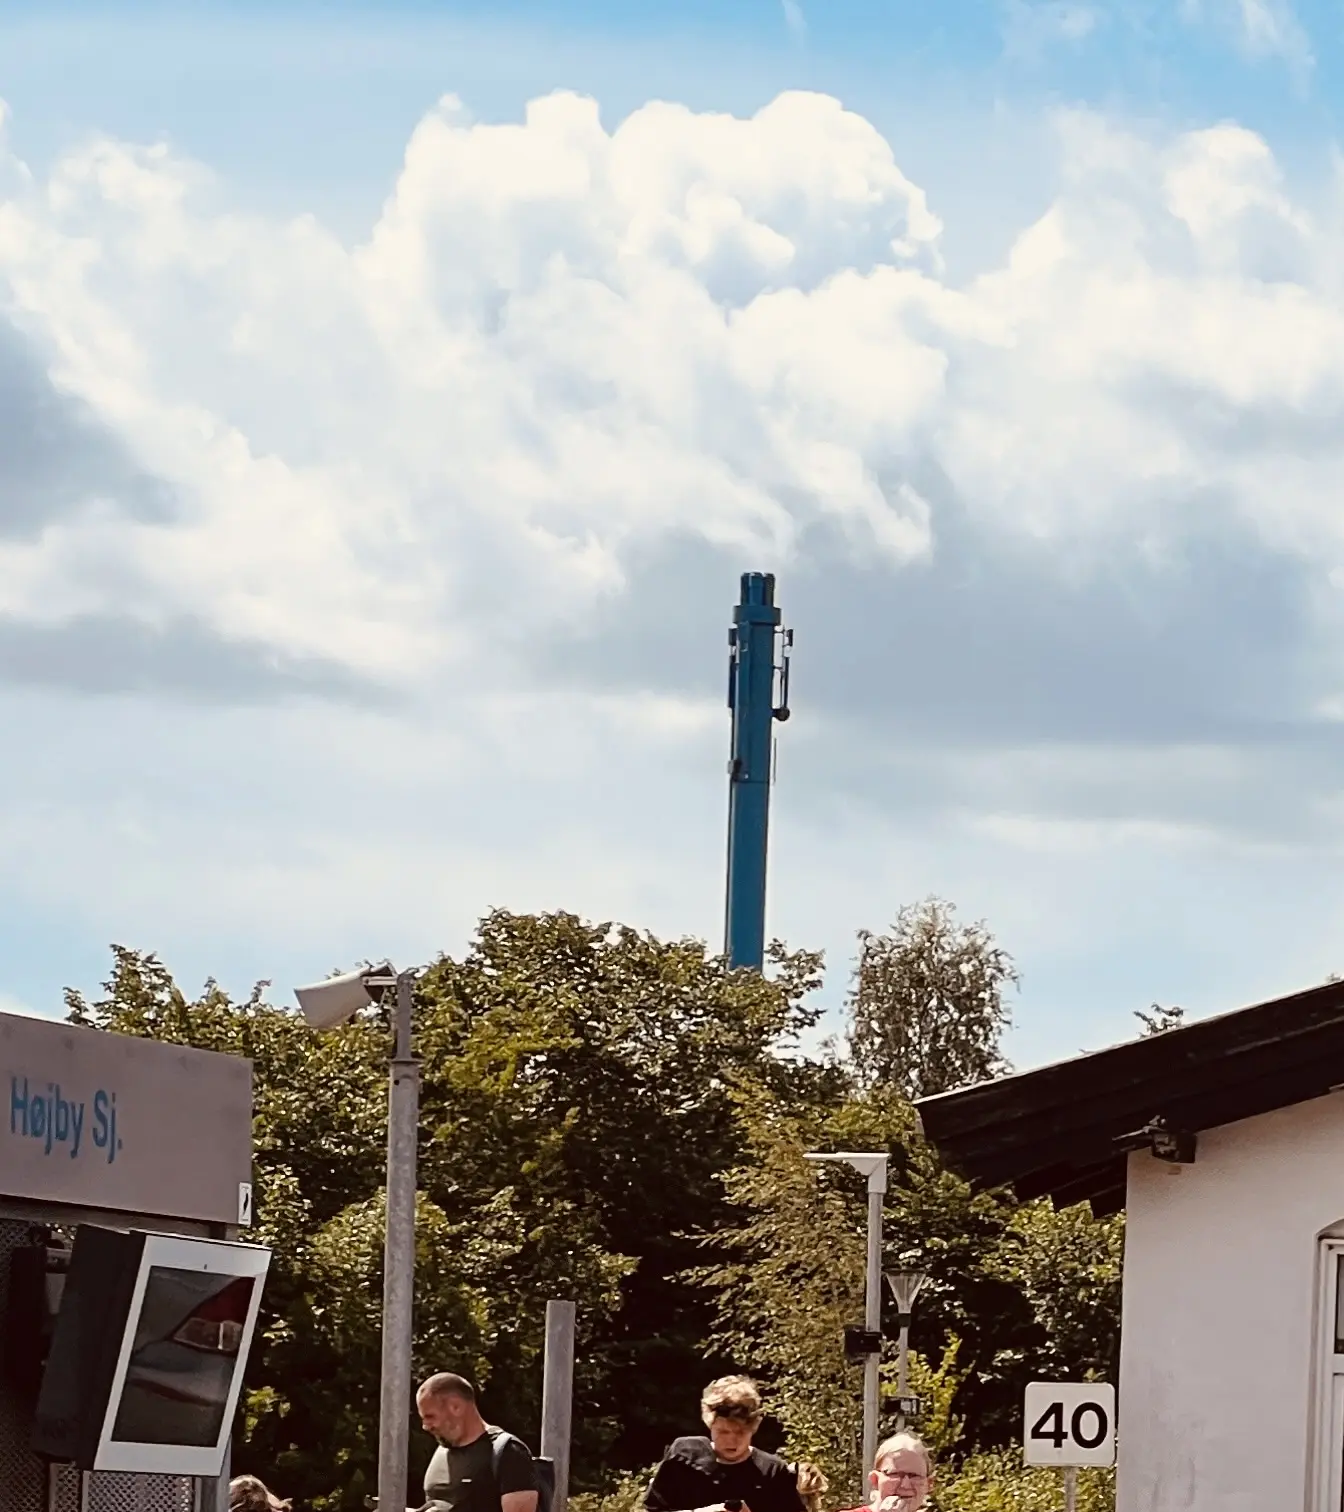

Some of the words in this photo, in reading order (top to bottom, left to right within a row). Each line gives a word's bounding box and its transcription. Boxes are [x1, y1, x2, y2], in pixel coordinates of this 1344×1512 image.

[11, 1076, 84, 1159] Højby
[92, 1089, 123, 1164] Sj.
[1031, 1402, 1108, 1449] 40
